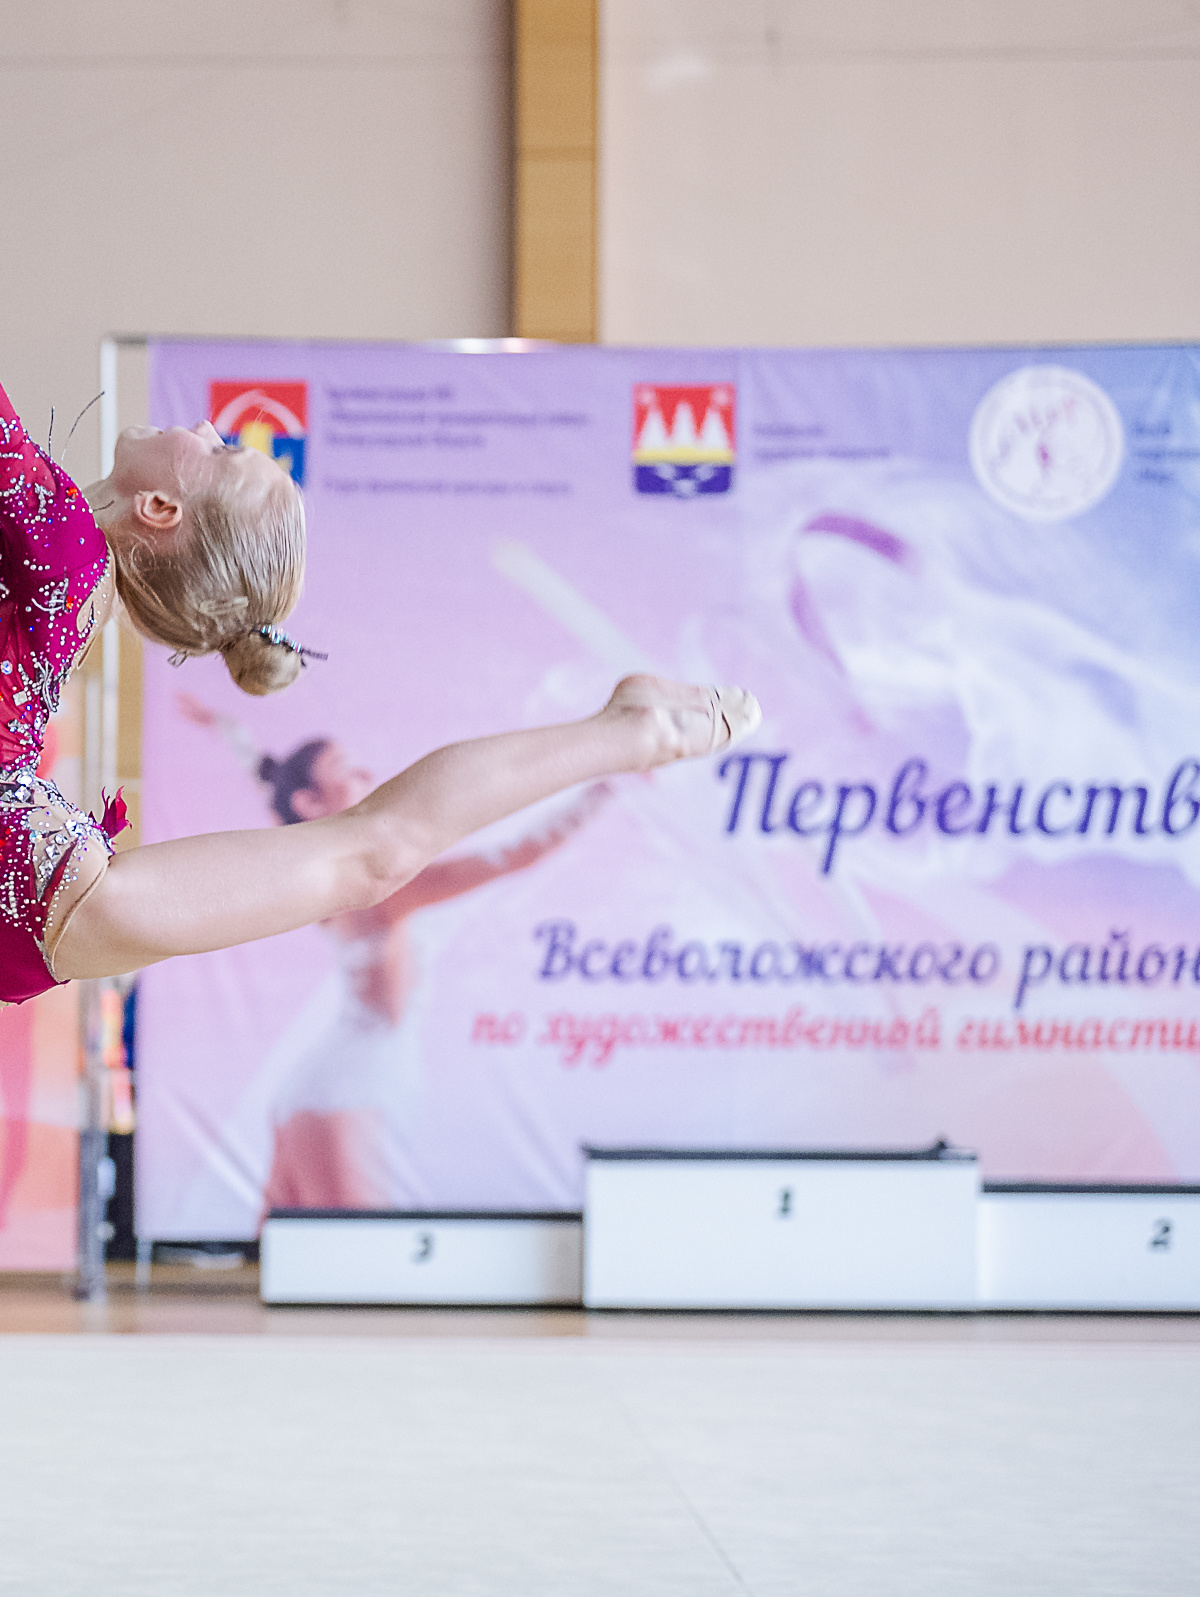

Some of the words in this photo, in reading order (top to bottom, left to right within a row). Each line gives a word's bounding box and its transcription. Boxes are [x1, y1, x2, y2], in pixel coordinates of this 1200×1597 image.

[719, 751, 1200, 876] Первенств
[533, 918, 1001, 984] Всеволожского
[471, 1011, 526, 1046] по
[536, 1003, 942, 1070] художественной
[777, 1185, 795, 1219] 1
[409, 1231, 436, 1264] 3
[1148, 1216, 1174, 1252] 2
